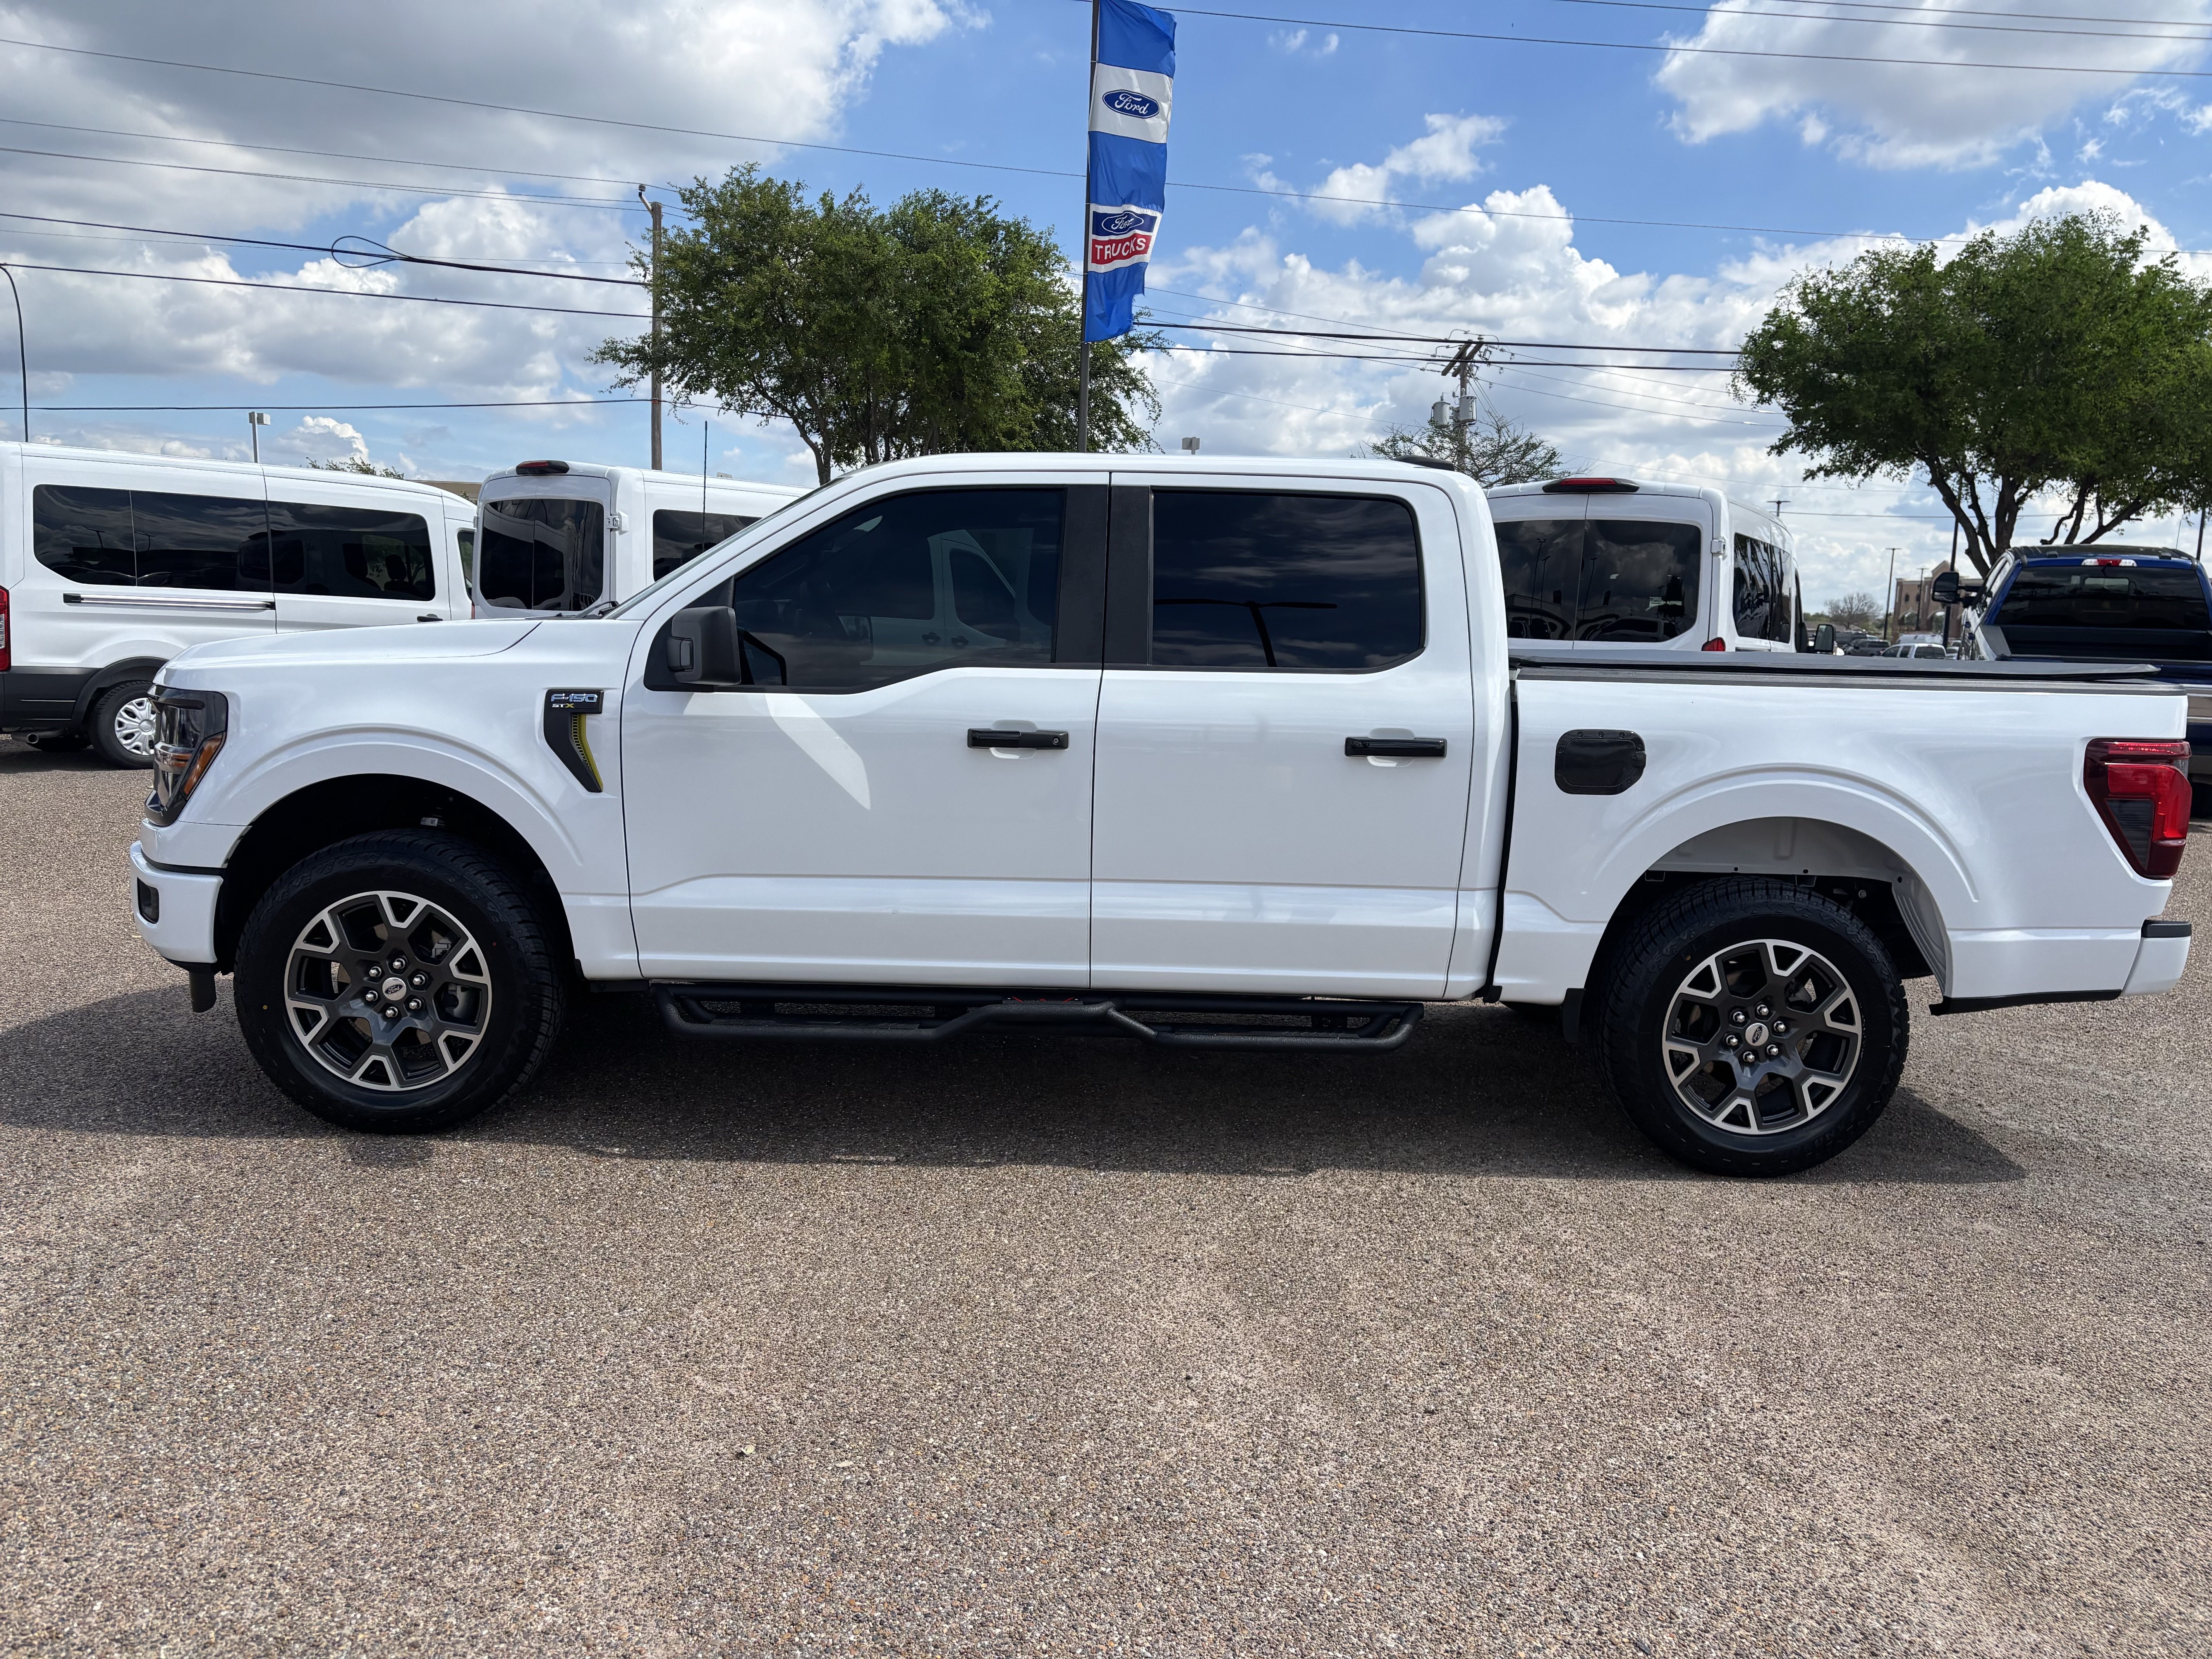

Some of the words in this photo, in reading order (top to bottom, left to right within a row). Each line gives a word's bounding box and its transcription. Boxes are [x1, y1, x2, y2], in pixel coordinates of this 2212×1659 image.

[1115, 93, 1150, 114] Ford
[1095, 237, 1146, 260] TRUCKS
[551, 693, 598, 702] F-150
[388, 985, 400, 994] Ford
[1753, 1028, 1762, 1041] Ford
